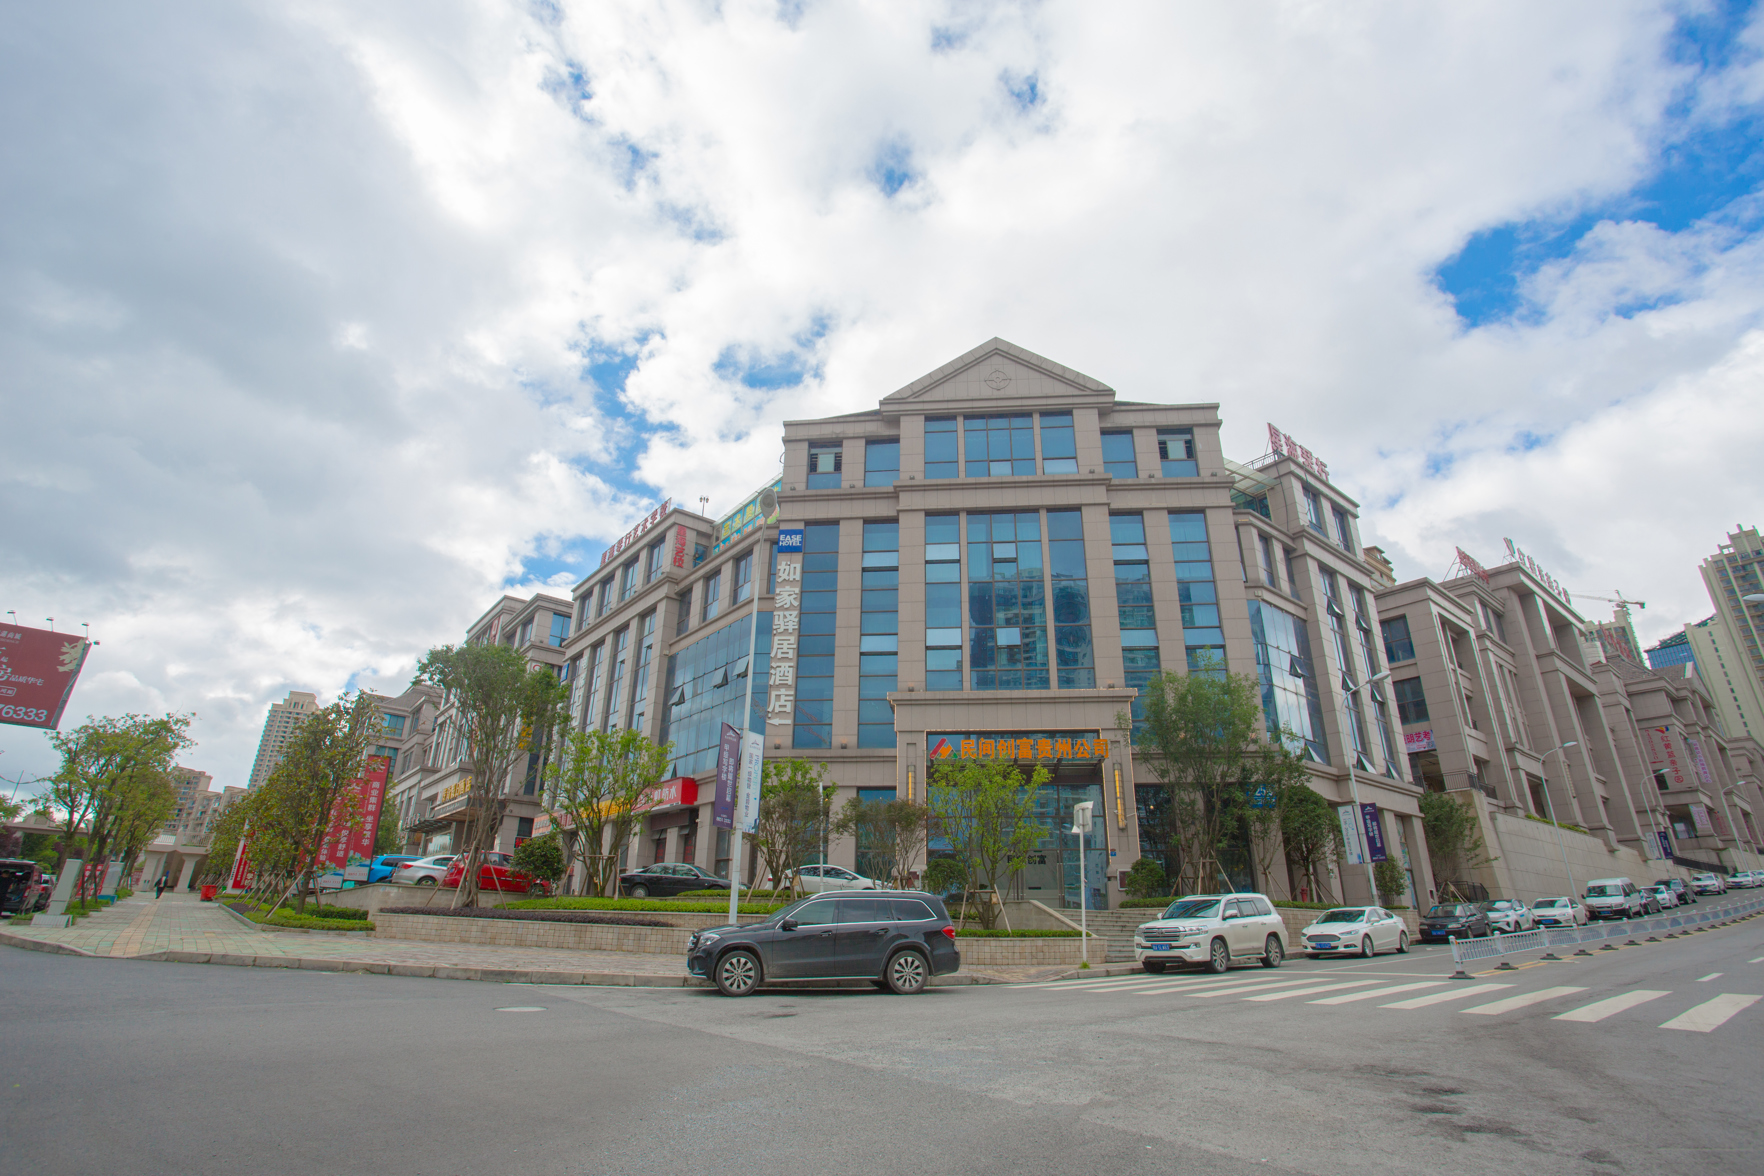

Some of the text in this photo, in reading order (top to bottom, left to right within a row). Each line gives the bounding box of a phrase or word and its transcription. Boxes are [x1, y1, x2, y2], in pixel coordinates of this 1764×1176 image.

[779, 534, 802, 542] EASE
[768, 561, 801, 714] 如家驿居酒店
[1404, 730, 1431, 744] 明艺考
[960, 738, 1109, 759] 民间创富贵州公司
[367, 781, 380, 811] 商业集群
